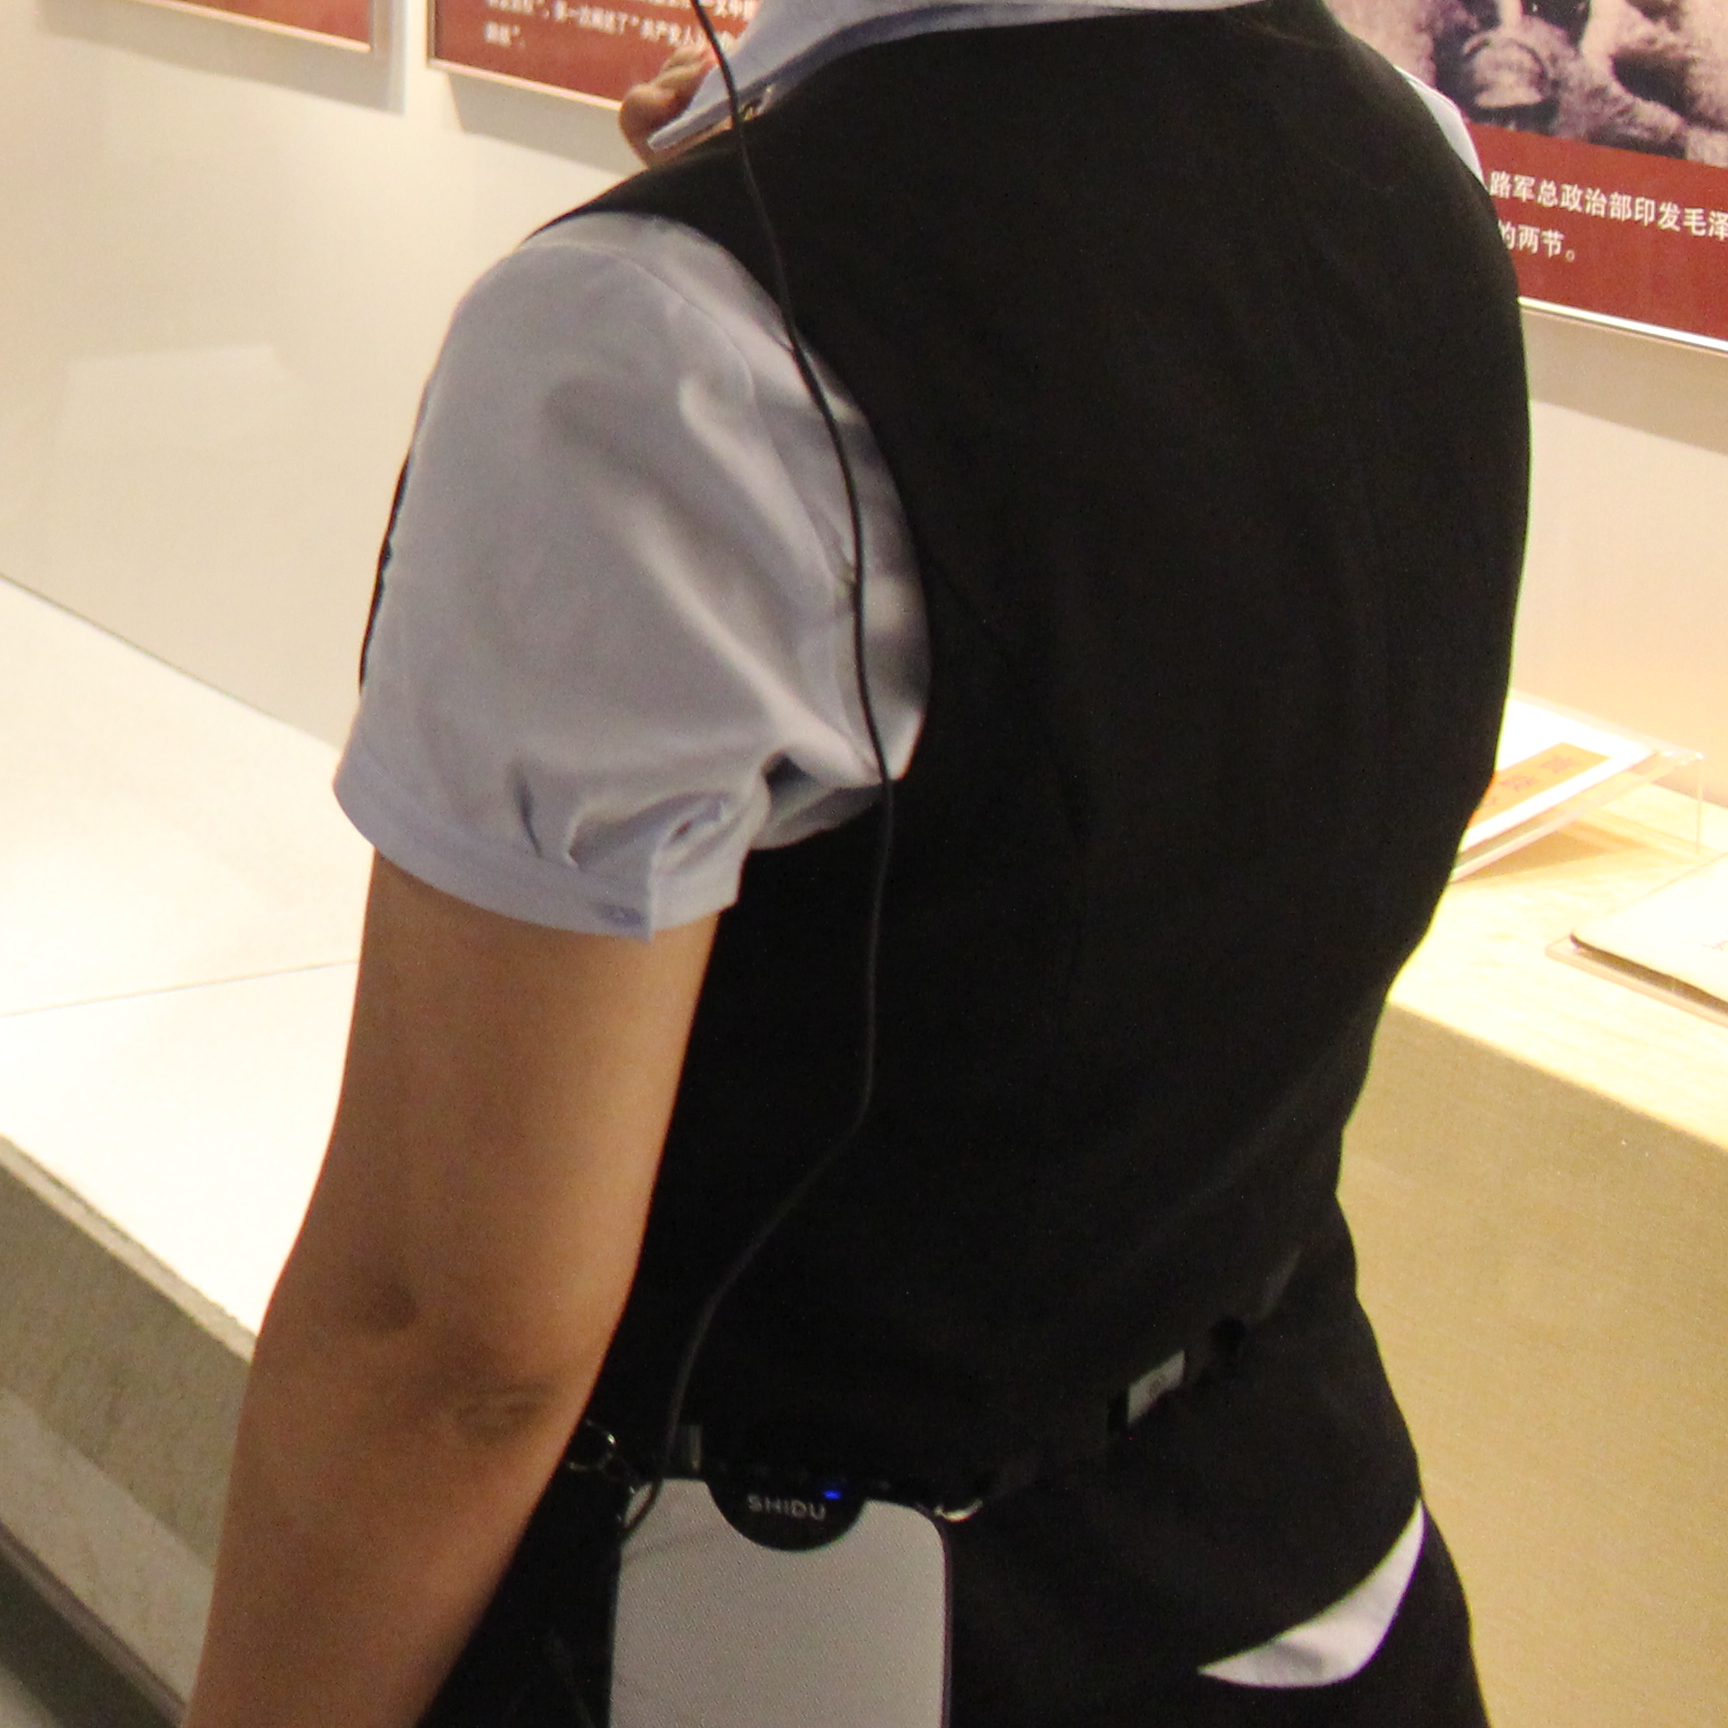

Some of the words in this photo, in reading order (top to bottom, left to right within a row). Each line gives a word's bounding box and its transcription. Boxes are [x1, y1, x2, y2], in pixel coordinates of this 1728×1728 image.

[1488, 170, 1728, 241] 路军总政治部印发毛泽
[747, 1493, 828, 1521] SHIDU
